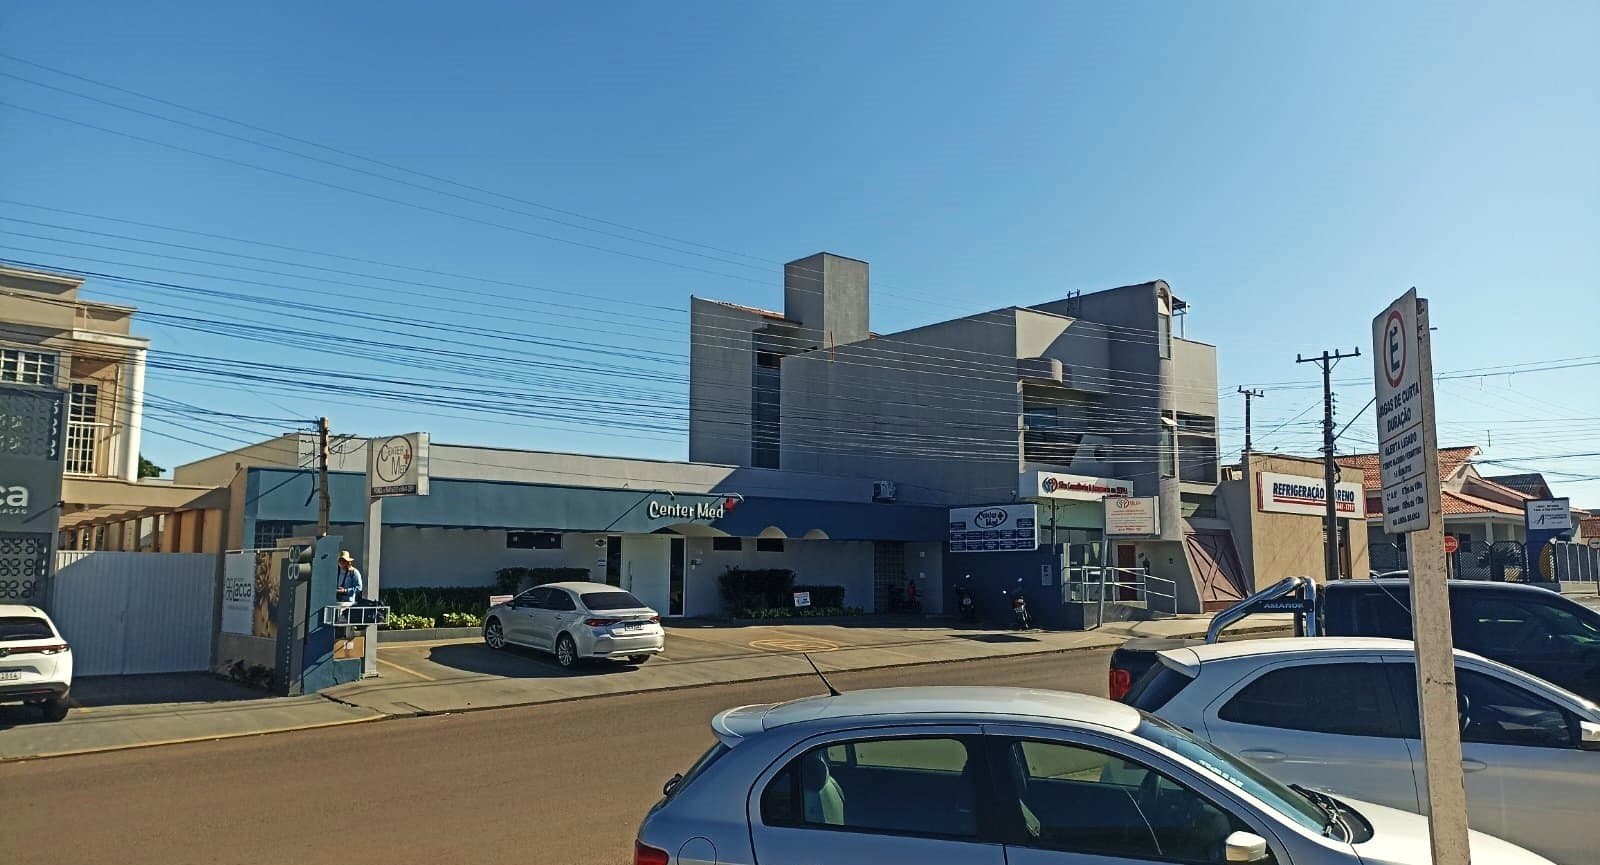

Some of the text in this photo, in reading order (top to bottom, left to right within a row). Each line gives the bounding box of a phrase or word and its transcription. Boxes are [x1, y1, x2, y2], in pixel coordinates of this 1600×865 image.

[1273, 482, 1325, 502] REFRIGERAÇÃO
[649, 500, 724, 519] Center Med
